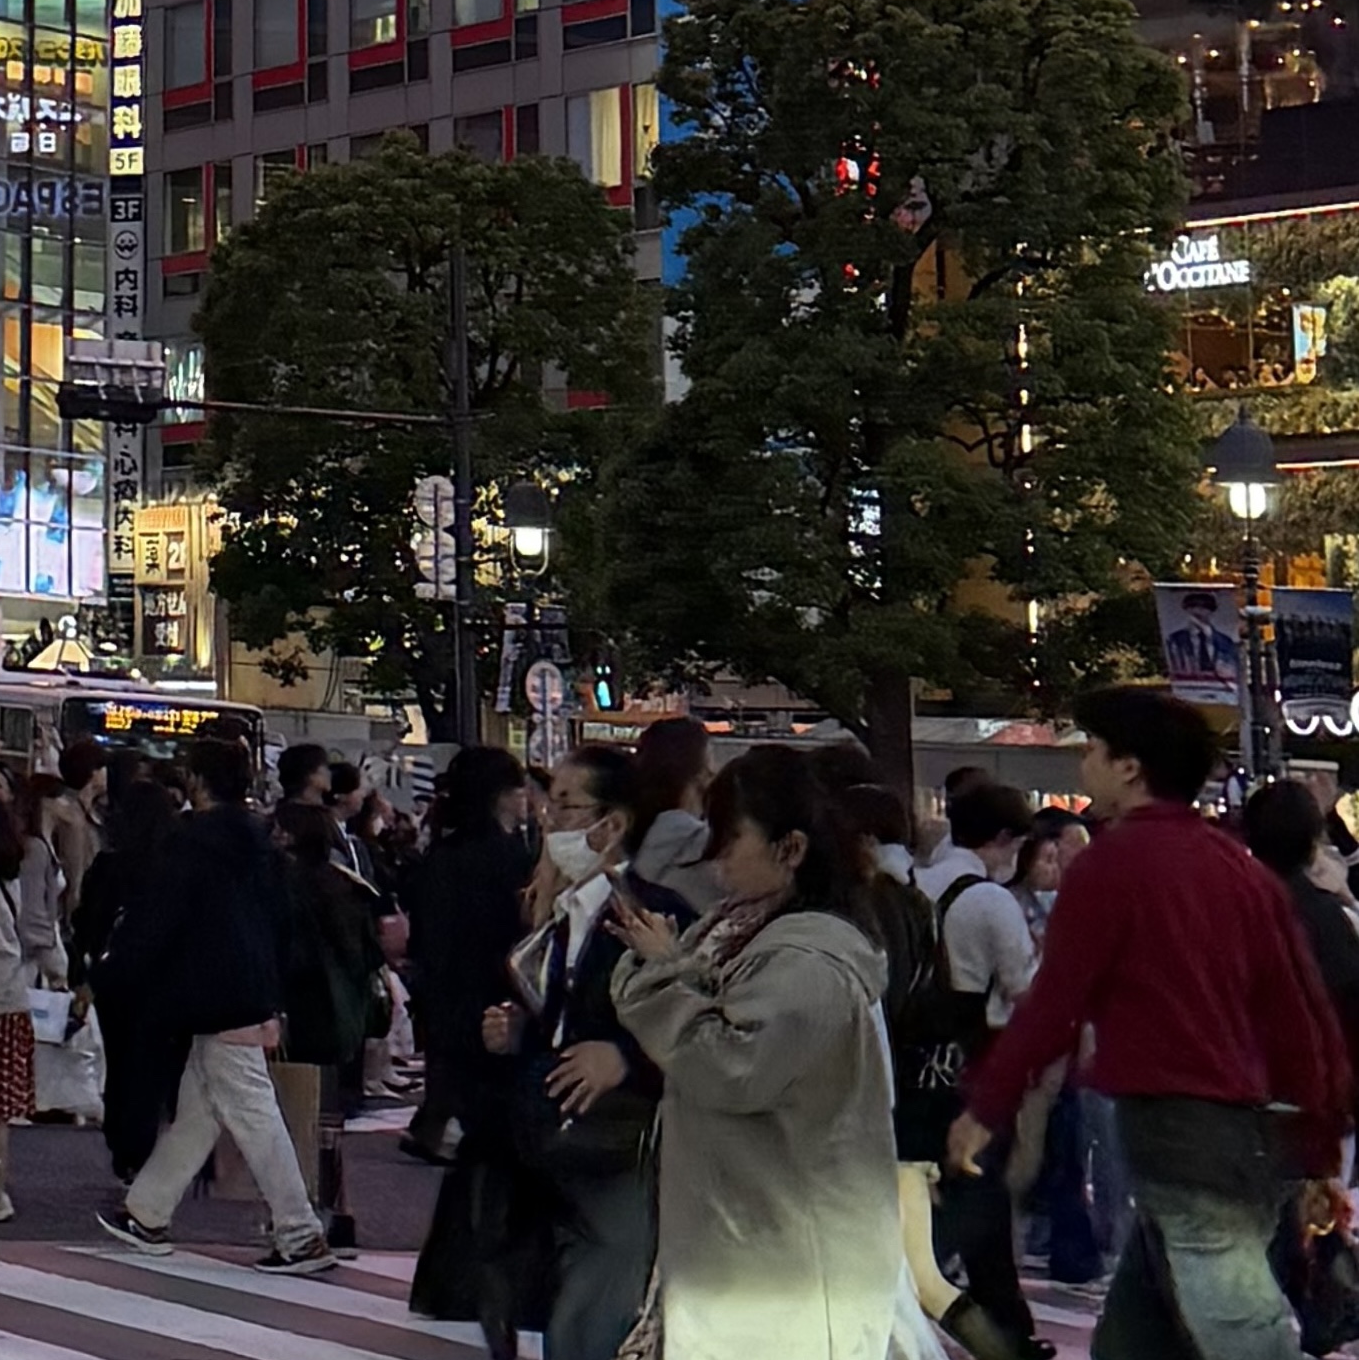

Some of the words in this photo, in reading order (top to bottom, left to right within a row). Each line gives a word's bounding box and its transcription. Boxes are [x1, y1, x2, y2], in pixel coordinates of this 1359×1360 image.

[114, 152, 140, 171] 5F
[114, 200, 141, 219] 3F
[1144, 259, 1251, 292] 'OCCITANE
[113, 267, 139, 318] 内科
